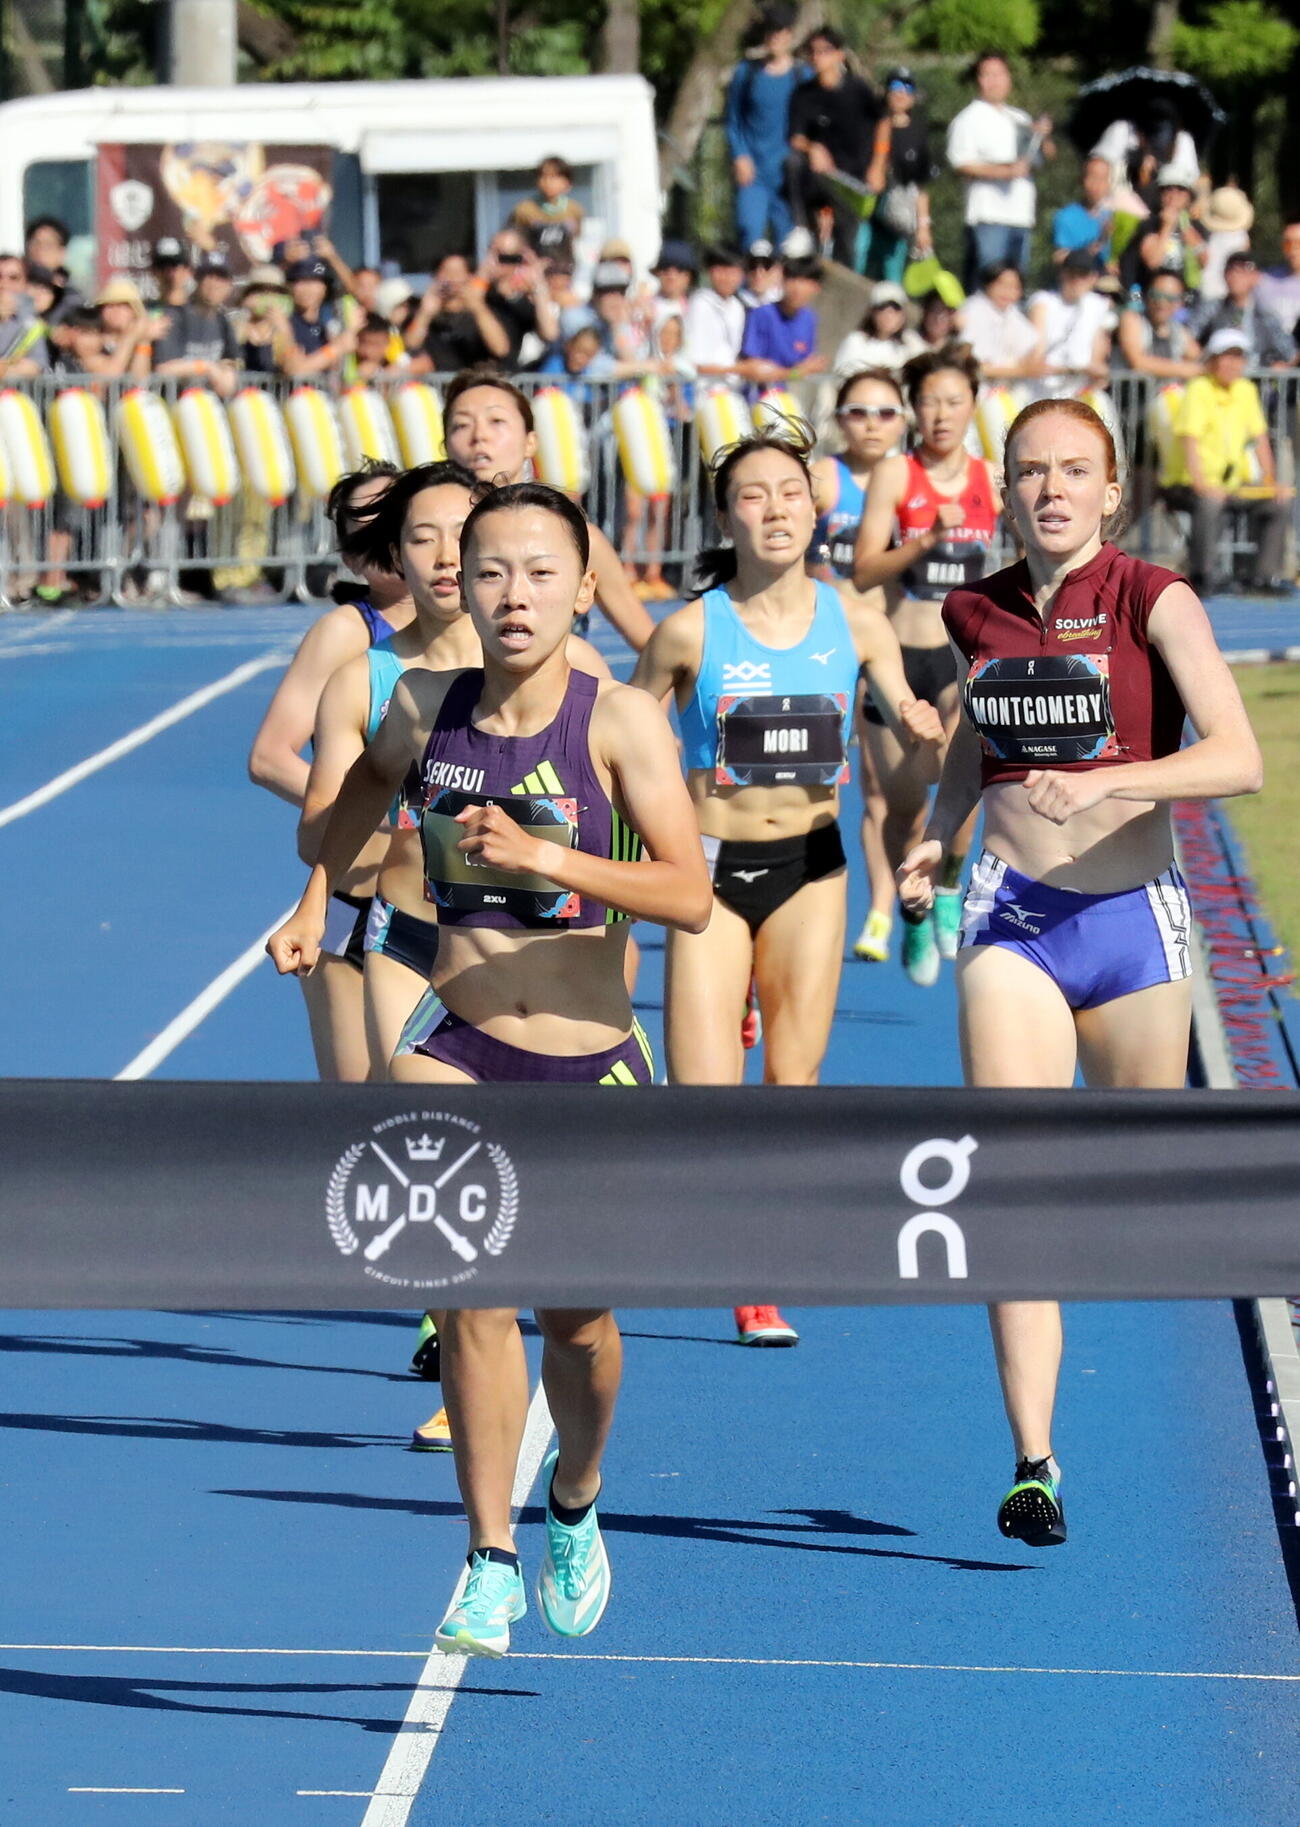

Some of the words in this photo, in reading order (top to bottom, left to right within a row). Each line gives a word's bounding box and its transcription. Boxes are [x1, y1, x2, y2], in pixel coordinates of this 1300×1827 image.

[1055, 613, 1107, 629] SOLVIVE
[972, 694, 1101, 725] MONTGOMERY
[763, 728, 808, 753] MORI
[1027, 745, 1057, 753] NAGASE
[423, 759, 485, 792] SEKISUI
[483, 895, 507, 904] 2XU
[373, 1111, 417, 1134] MIDDLE
[421, 1110, 480, 1133] DISTANCE
[364, 1266, 410, 1288] CIRCUIT
[413, 1277, 448, 1288] SINCE
